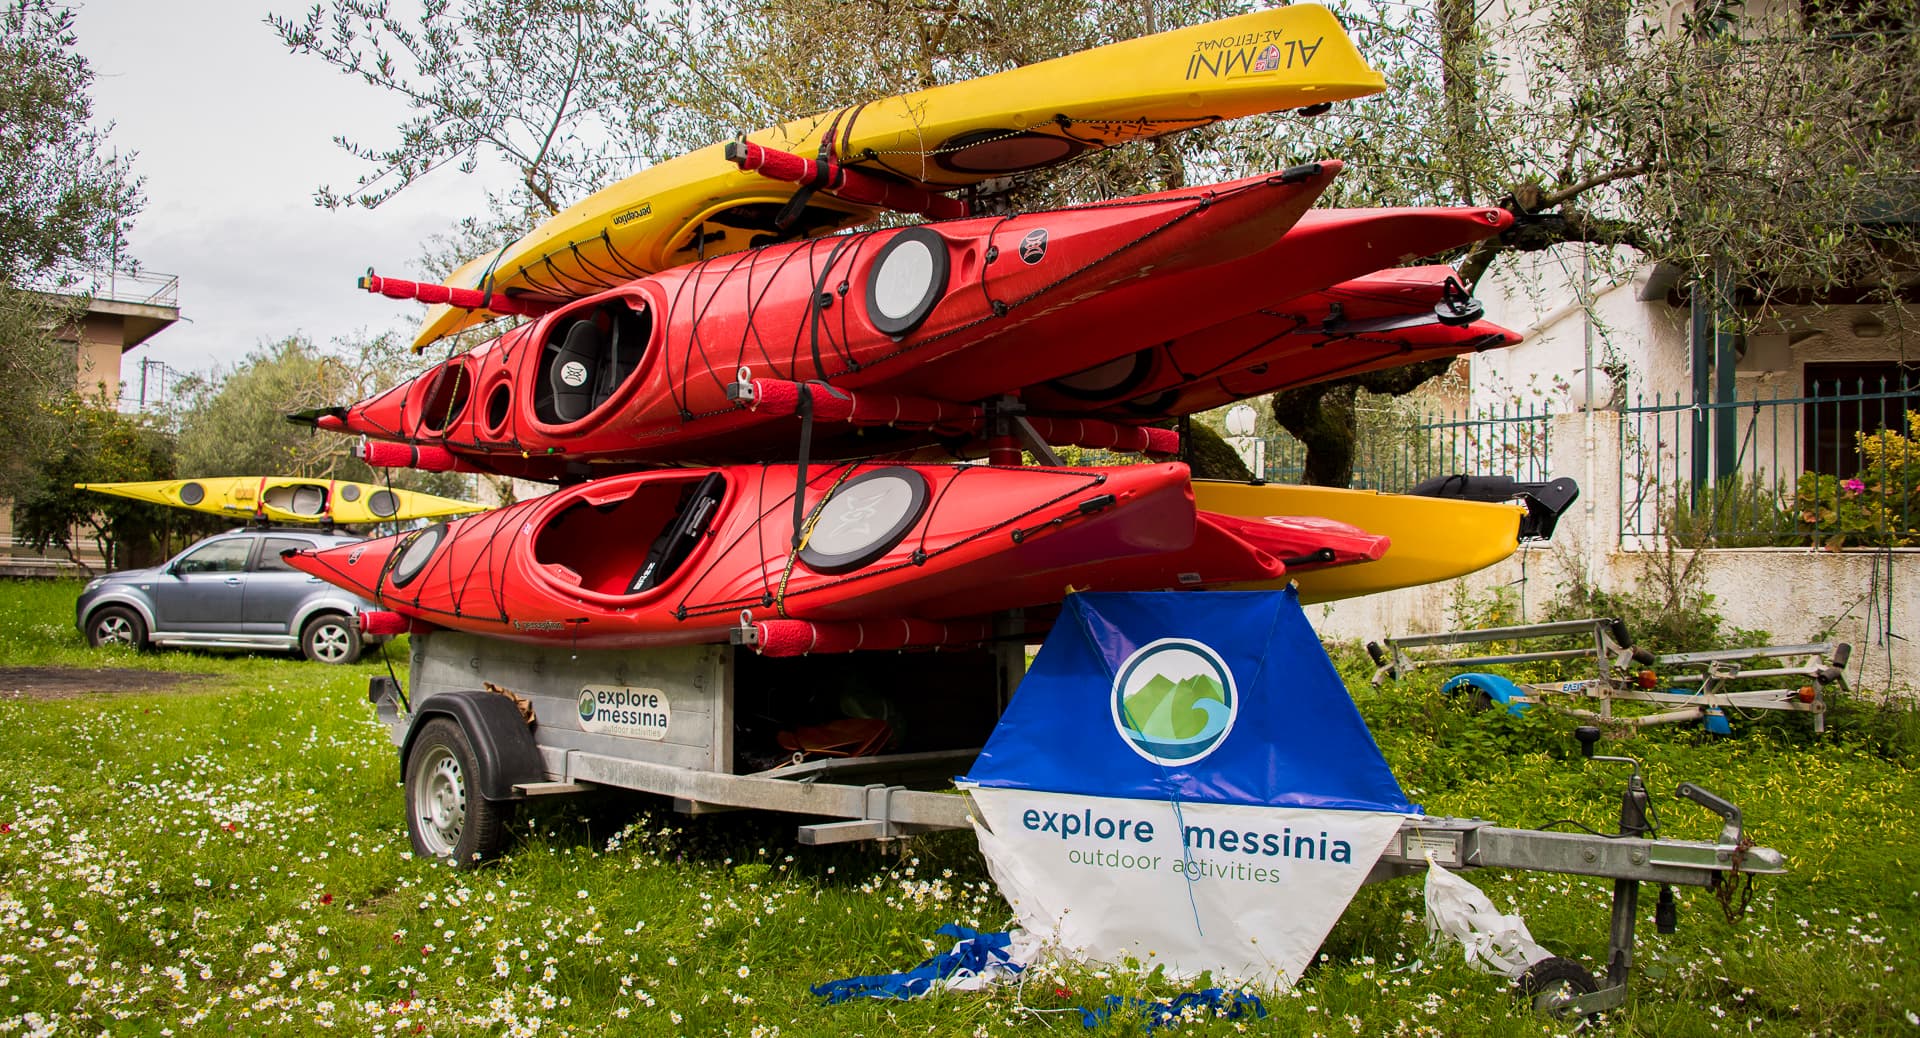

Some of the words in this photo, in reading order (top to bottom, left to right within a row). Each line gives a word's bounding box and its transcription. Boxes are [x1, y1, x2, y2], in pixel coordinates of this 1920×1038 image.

[613, 203, 652, 225] perception
[597, 688, 658, 708] explore
[597, 708, 667, 728] messinia
[1022, 808, 1154, 843] explore
[1184, 825, 1352, 864] messinia
[1068, 849, 1161, 871] outdoor
[1172, 857, 1281, 883] activities
